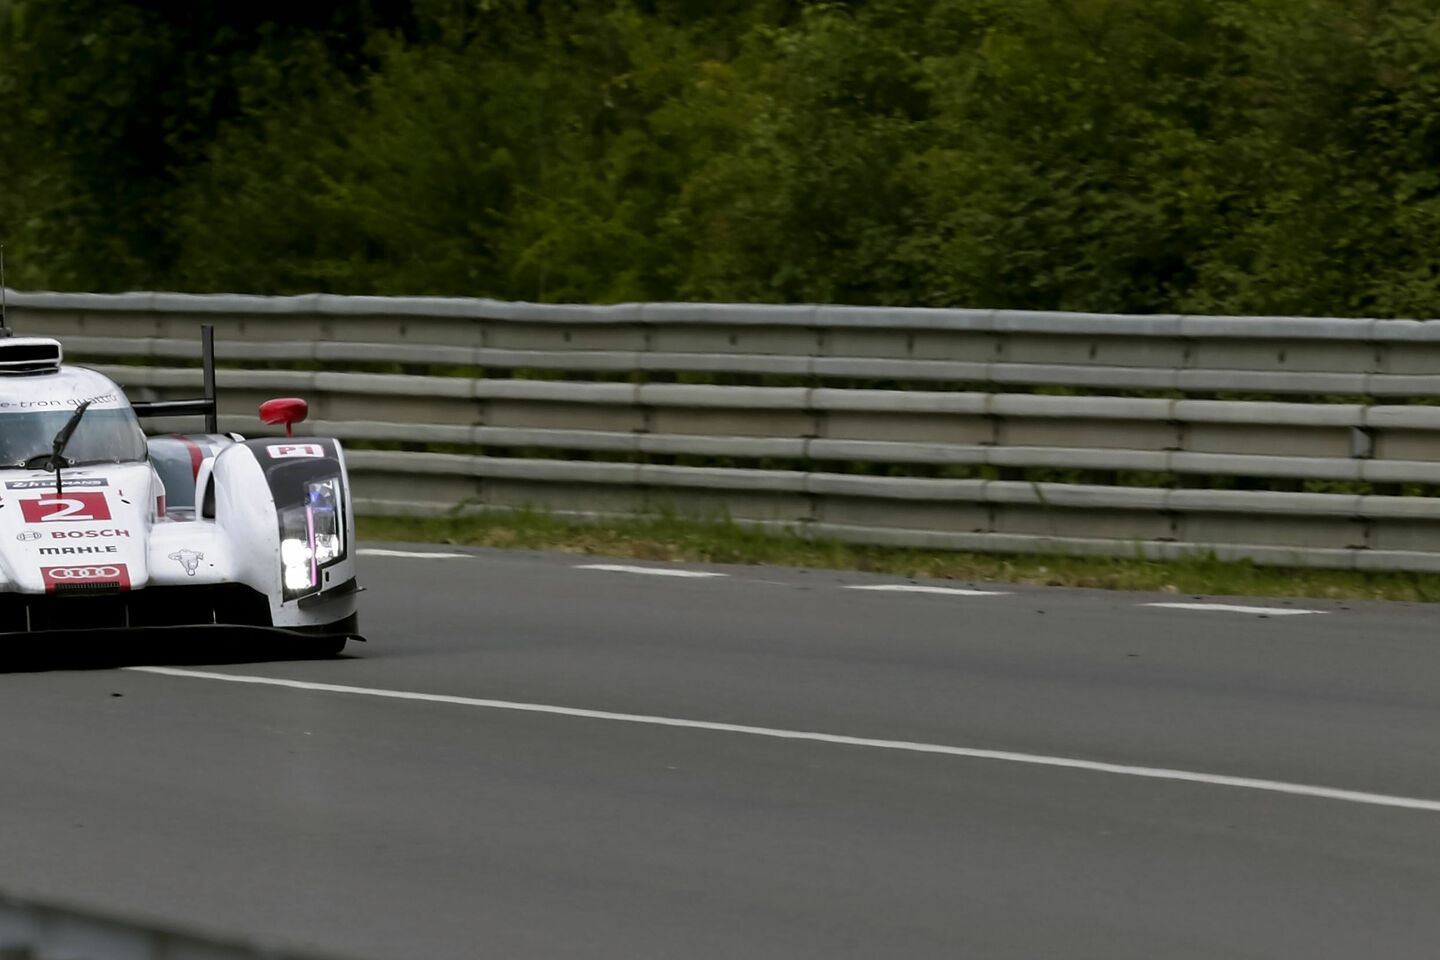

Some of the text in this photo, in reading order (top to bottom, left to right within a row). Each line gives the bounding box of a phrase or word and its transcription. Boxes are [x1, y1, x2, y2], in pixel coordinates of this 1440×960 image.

[0, 399, 61, 409] e-tron
[38, 498, 94, 521] 2
[51, 528, 130, 539] BOSCH
[39, 545, 118, 555] MAHLE
